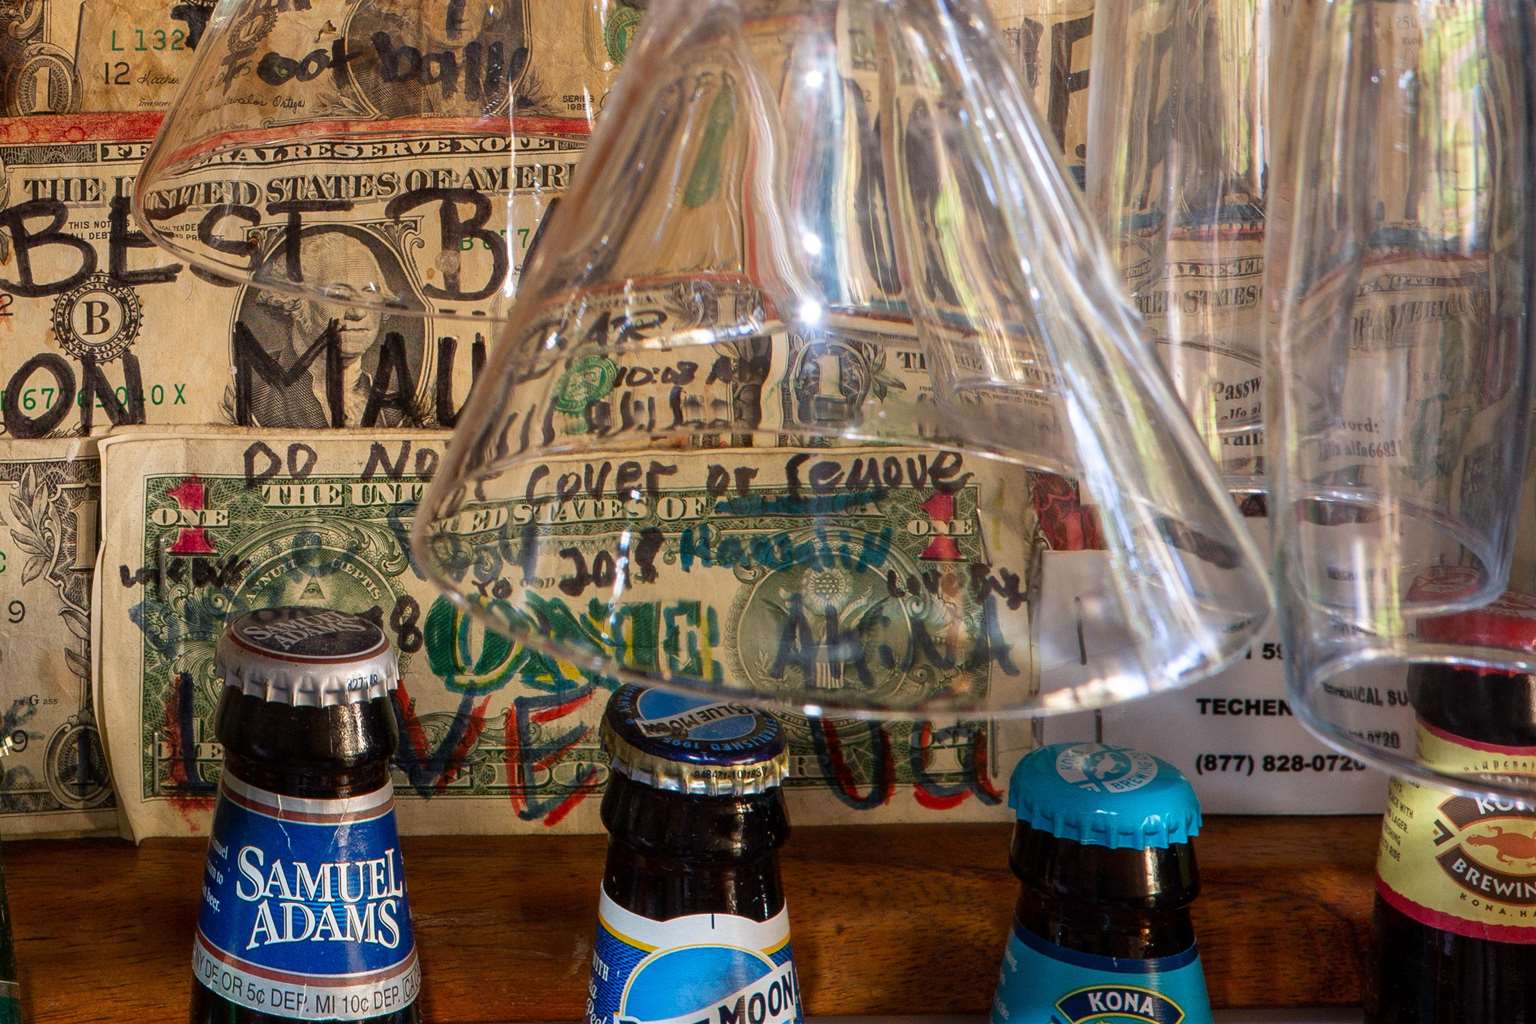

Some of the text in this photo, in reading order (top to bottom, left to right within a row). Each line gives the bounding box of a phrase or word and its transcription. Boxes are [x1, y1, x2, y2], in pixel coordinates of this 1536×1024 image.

[111, 28, 186, 52] L132
[103, 61, 131, 86] 12
[265, 174, 400, 205] STATES
[464, 162, 576, 193] AMERI
[81, 300, 111, 336] B
[2, 318, 488, 439] ON MAU
[243, 441, 318, 486] DO
[263, 482, 344, 508] THE
[150, 508, 230, 528] ONE
[8, 599, 26, 624] 9
[1196, 697, 1293, 717] TECHEN
[11, 729, 28, 752] 9
[1195, 754, 1255, 777] (877)
[235, 844, 404, 904] SAMUEL
[1451, 857, 1536, 899] BREWIN
[245, 898, 401, 951] ADAMS
[221, 973, 243, 998] OR
[271, 987, 310, 1014] DEP.
[315, 993, 336, 1014] MI
[373, 985, 402, 1011] DEP.
[1087, 990, 1156, 1018] KONA
